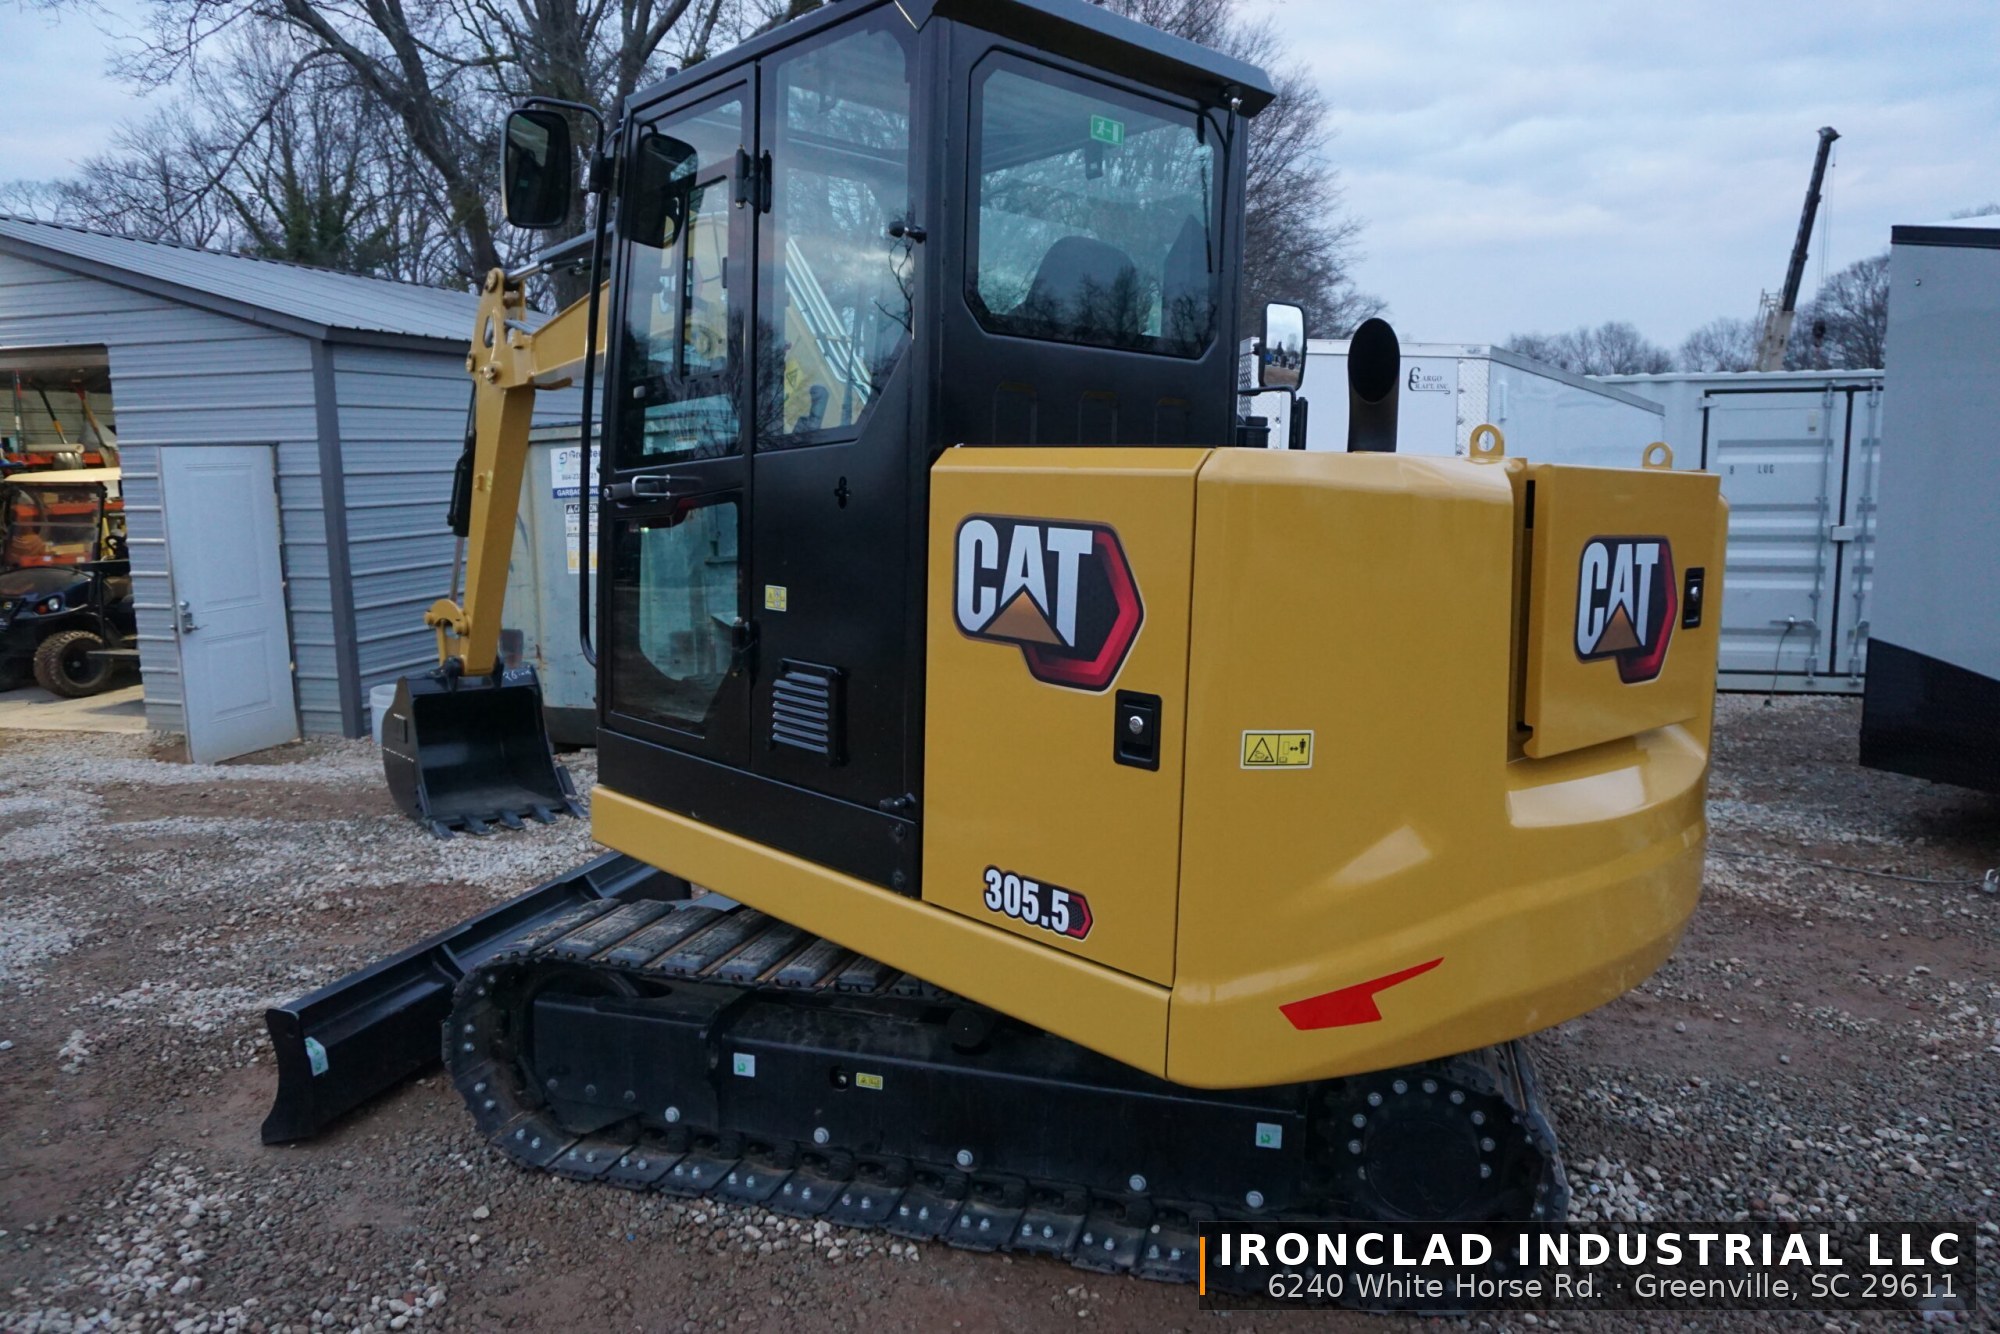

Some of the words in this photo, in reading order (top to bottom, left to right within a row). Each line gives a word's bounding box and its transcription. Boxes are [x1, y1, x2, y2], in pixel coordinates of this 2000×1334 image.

[957, 519, 1093, 647] CAT
[1577, 542, 1660, 654] CAT
[985, 868, 1069, 932] 305.5
